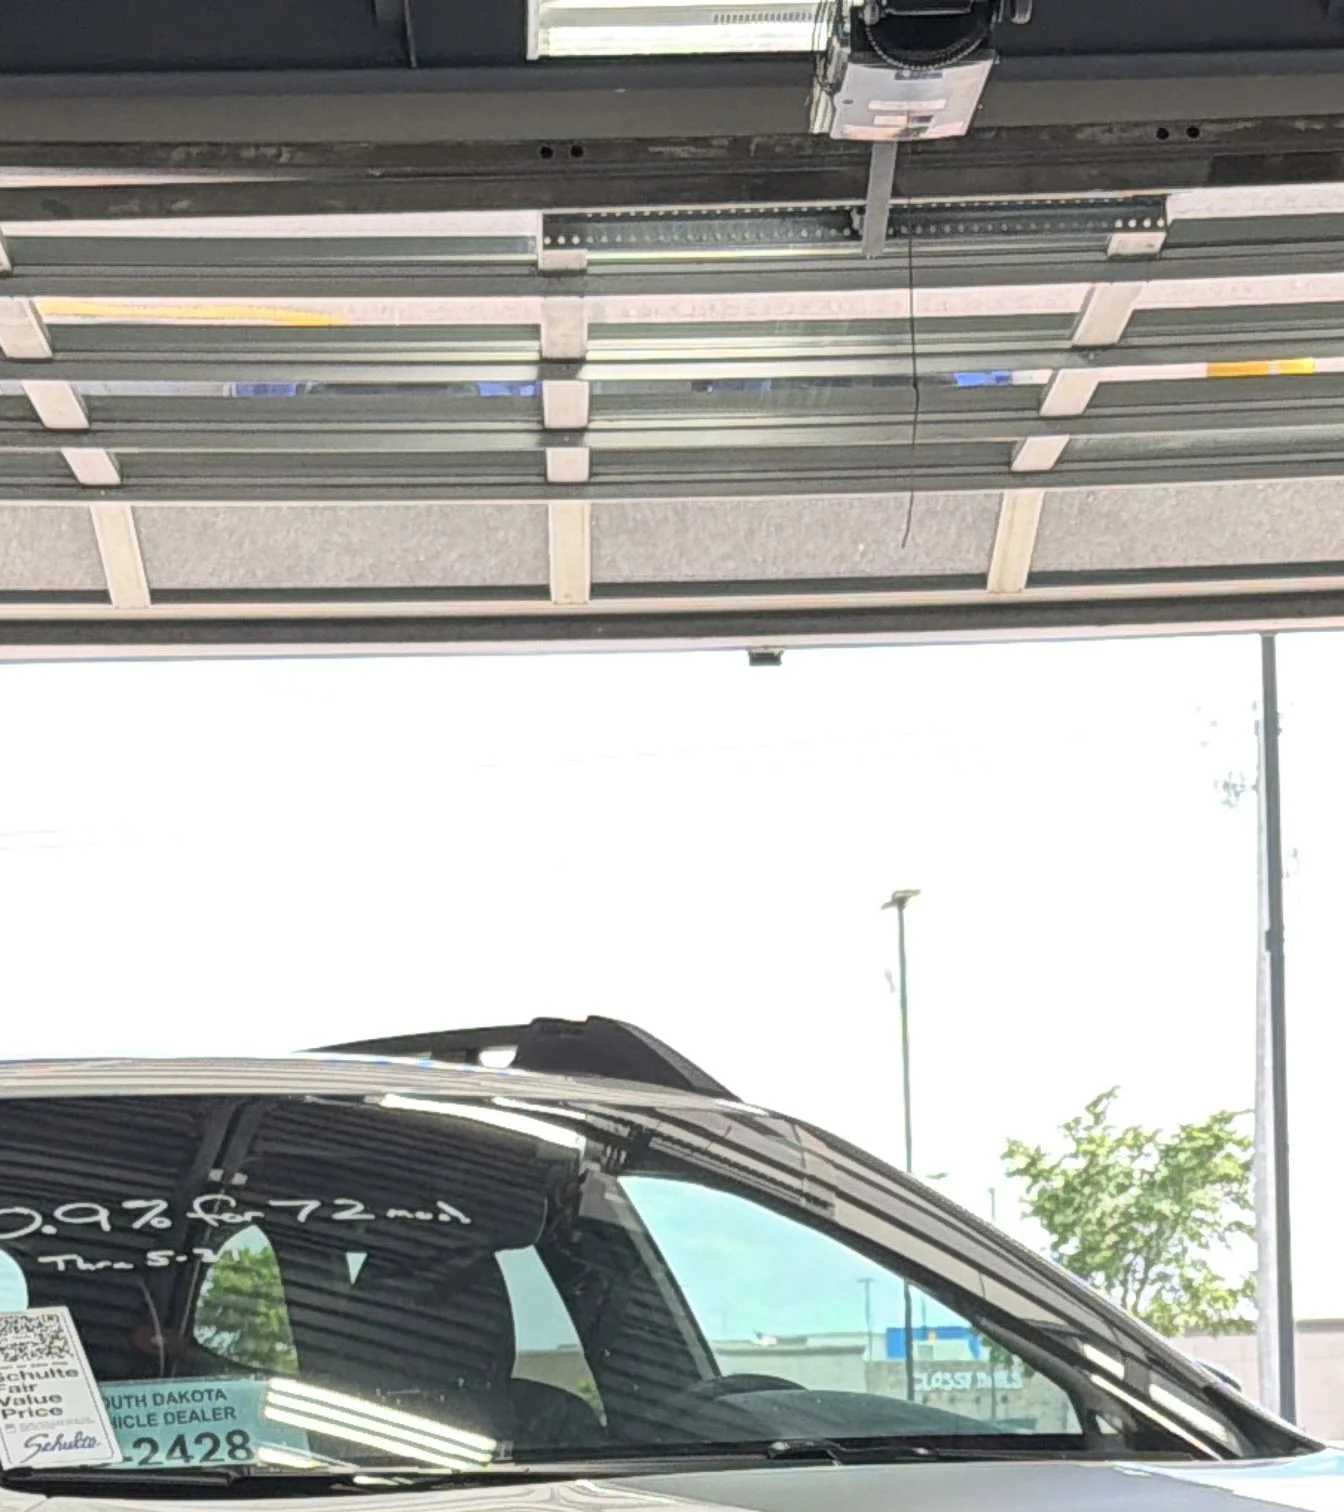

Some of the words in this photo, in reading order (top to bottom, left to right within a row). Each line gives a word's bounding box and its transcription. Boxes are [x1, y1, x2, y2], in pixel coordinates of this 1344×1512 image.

[269, 1197, 376, 1224] 72
[102, 1393, 148, 1410] OUTH
[152, 1388, 228, 1407] DAKOTA
[1, 1406, 64, 1420] Price
[163, 1406, 237, 1426] DEALER
